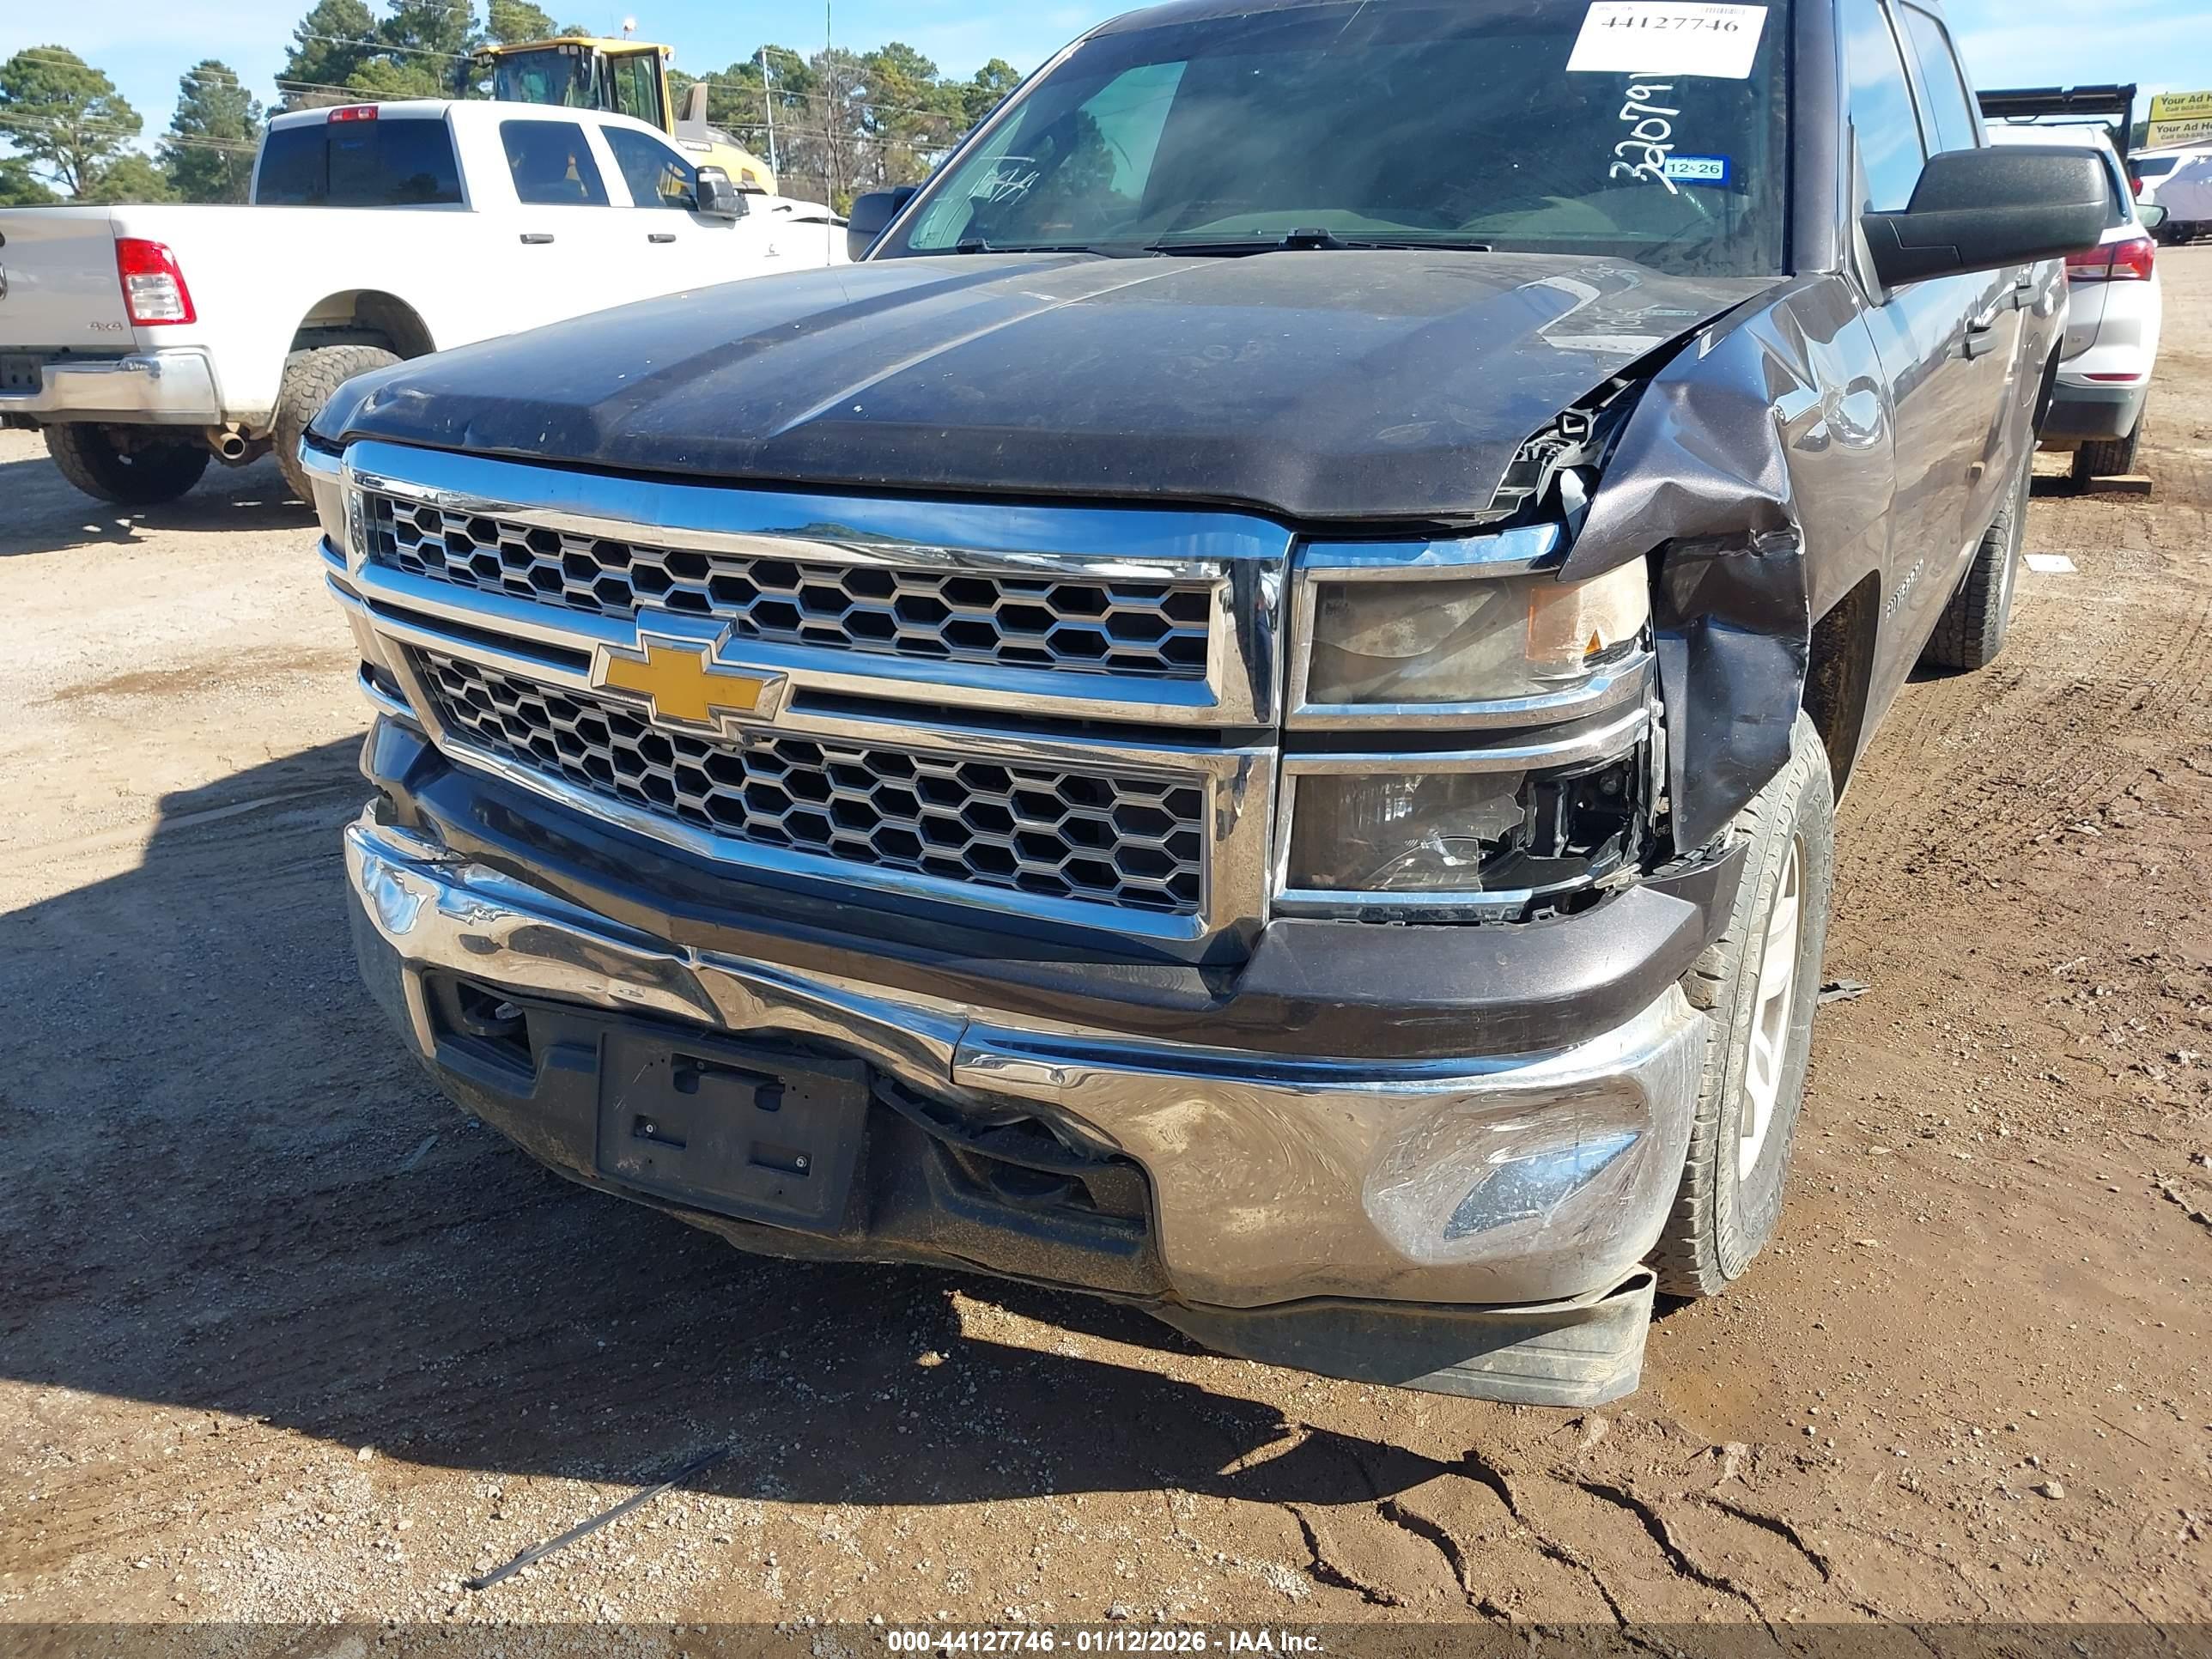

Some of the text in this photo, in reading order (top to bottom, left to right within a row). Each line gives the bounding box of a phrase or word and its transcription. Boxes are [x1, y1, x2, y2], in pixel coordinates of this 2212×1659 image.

[1601, 16, 1739, 33] 44127746
[2160, 96, 2185, 105] Your
[88, 321, 124, 331] 4x4
